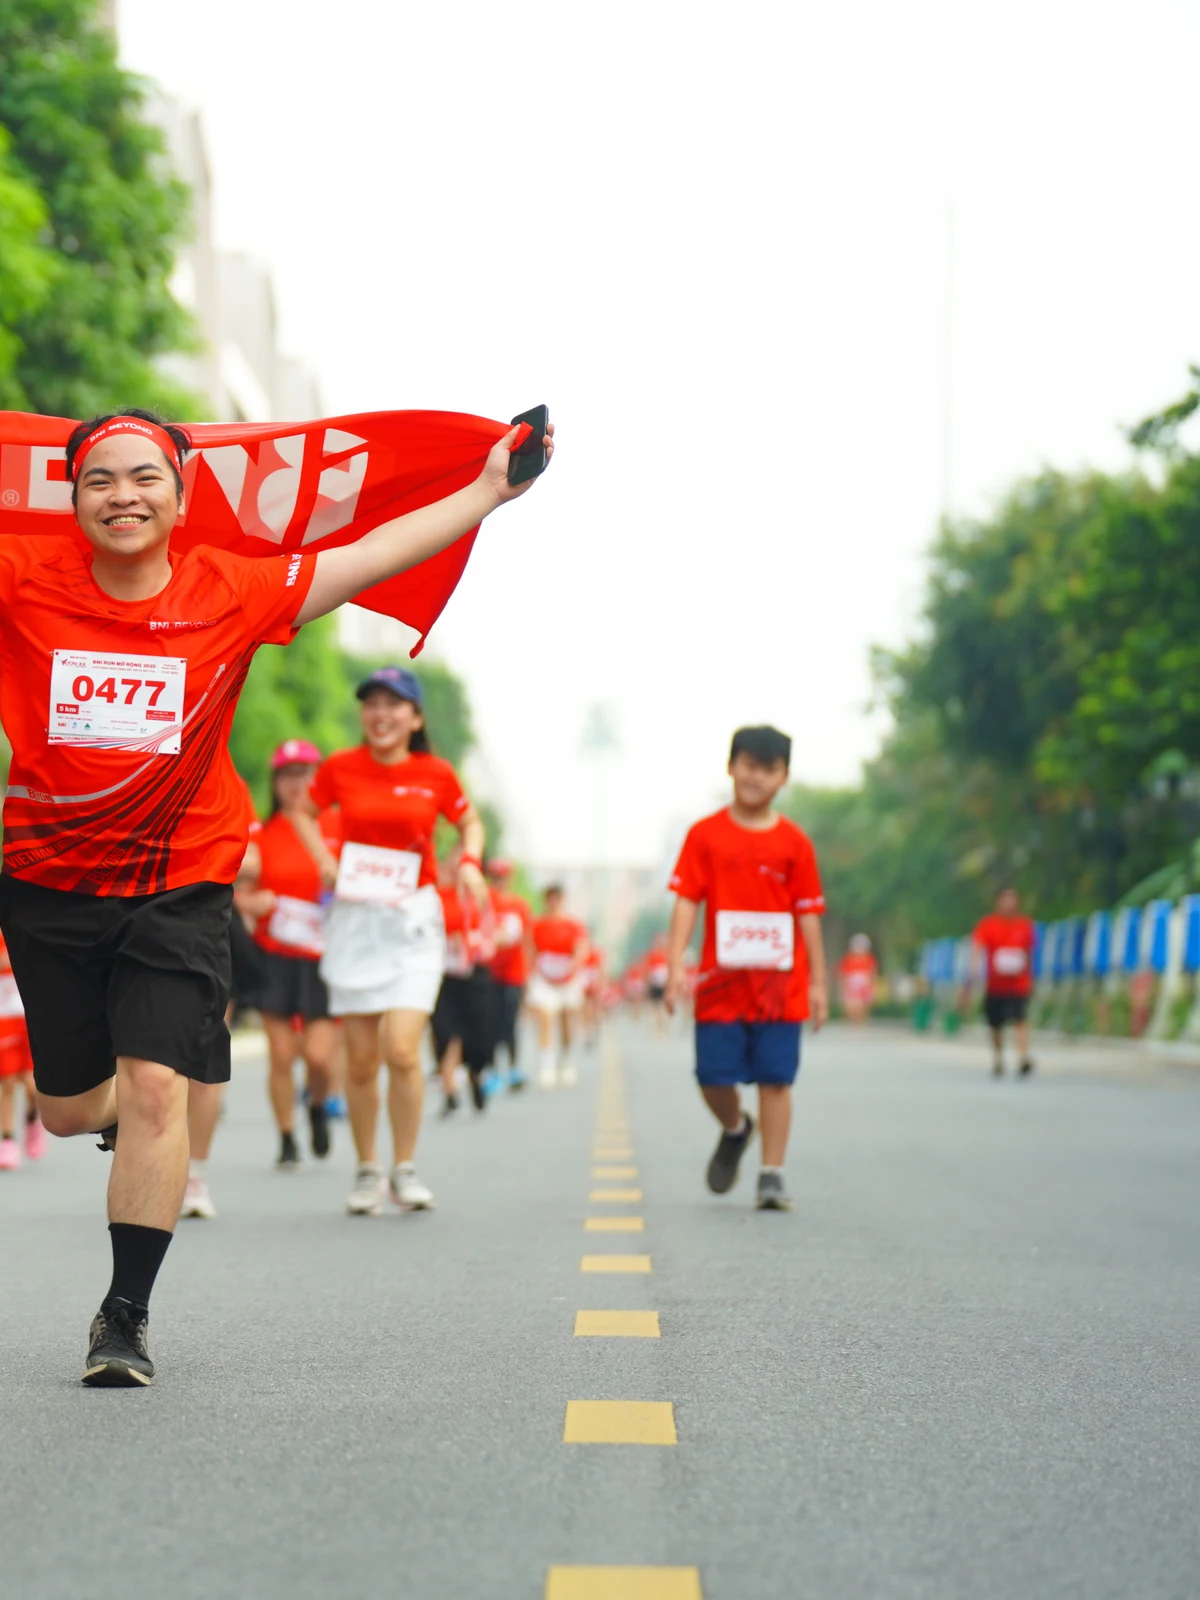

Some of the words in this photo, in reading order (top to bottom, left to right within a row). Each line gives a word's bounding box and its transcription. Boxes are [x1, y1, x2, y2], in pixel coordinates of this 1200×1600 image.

[90, 429, 106, 442] BNI
[108, 422, 153, 435] BEYOND
[149, 621, 170, 631] BNI
[71, 675, 166, 706] 0477
